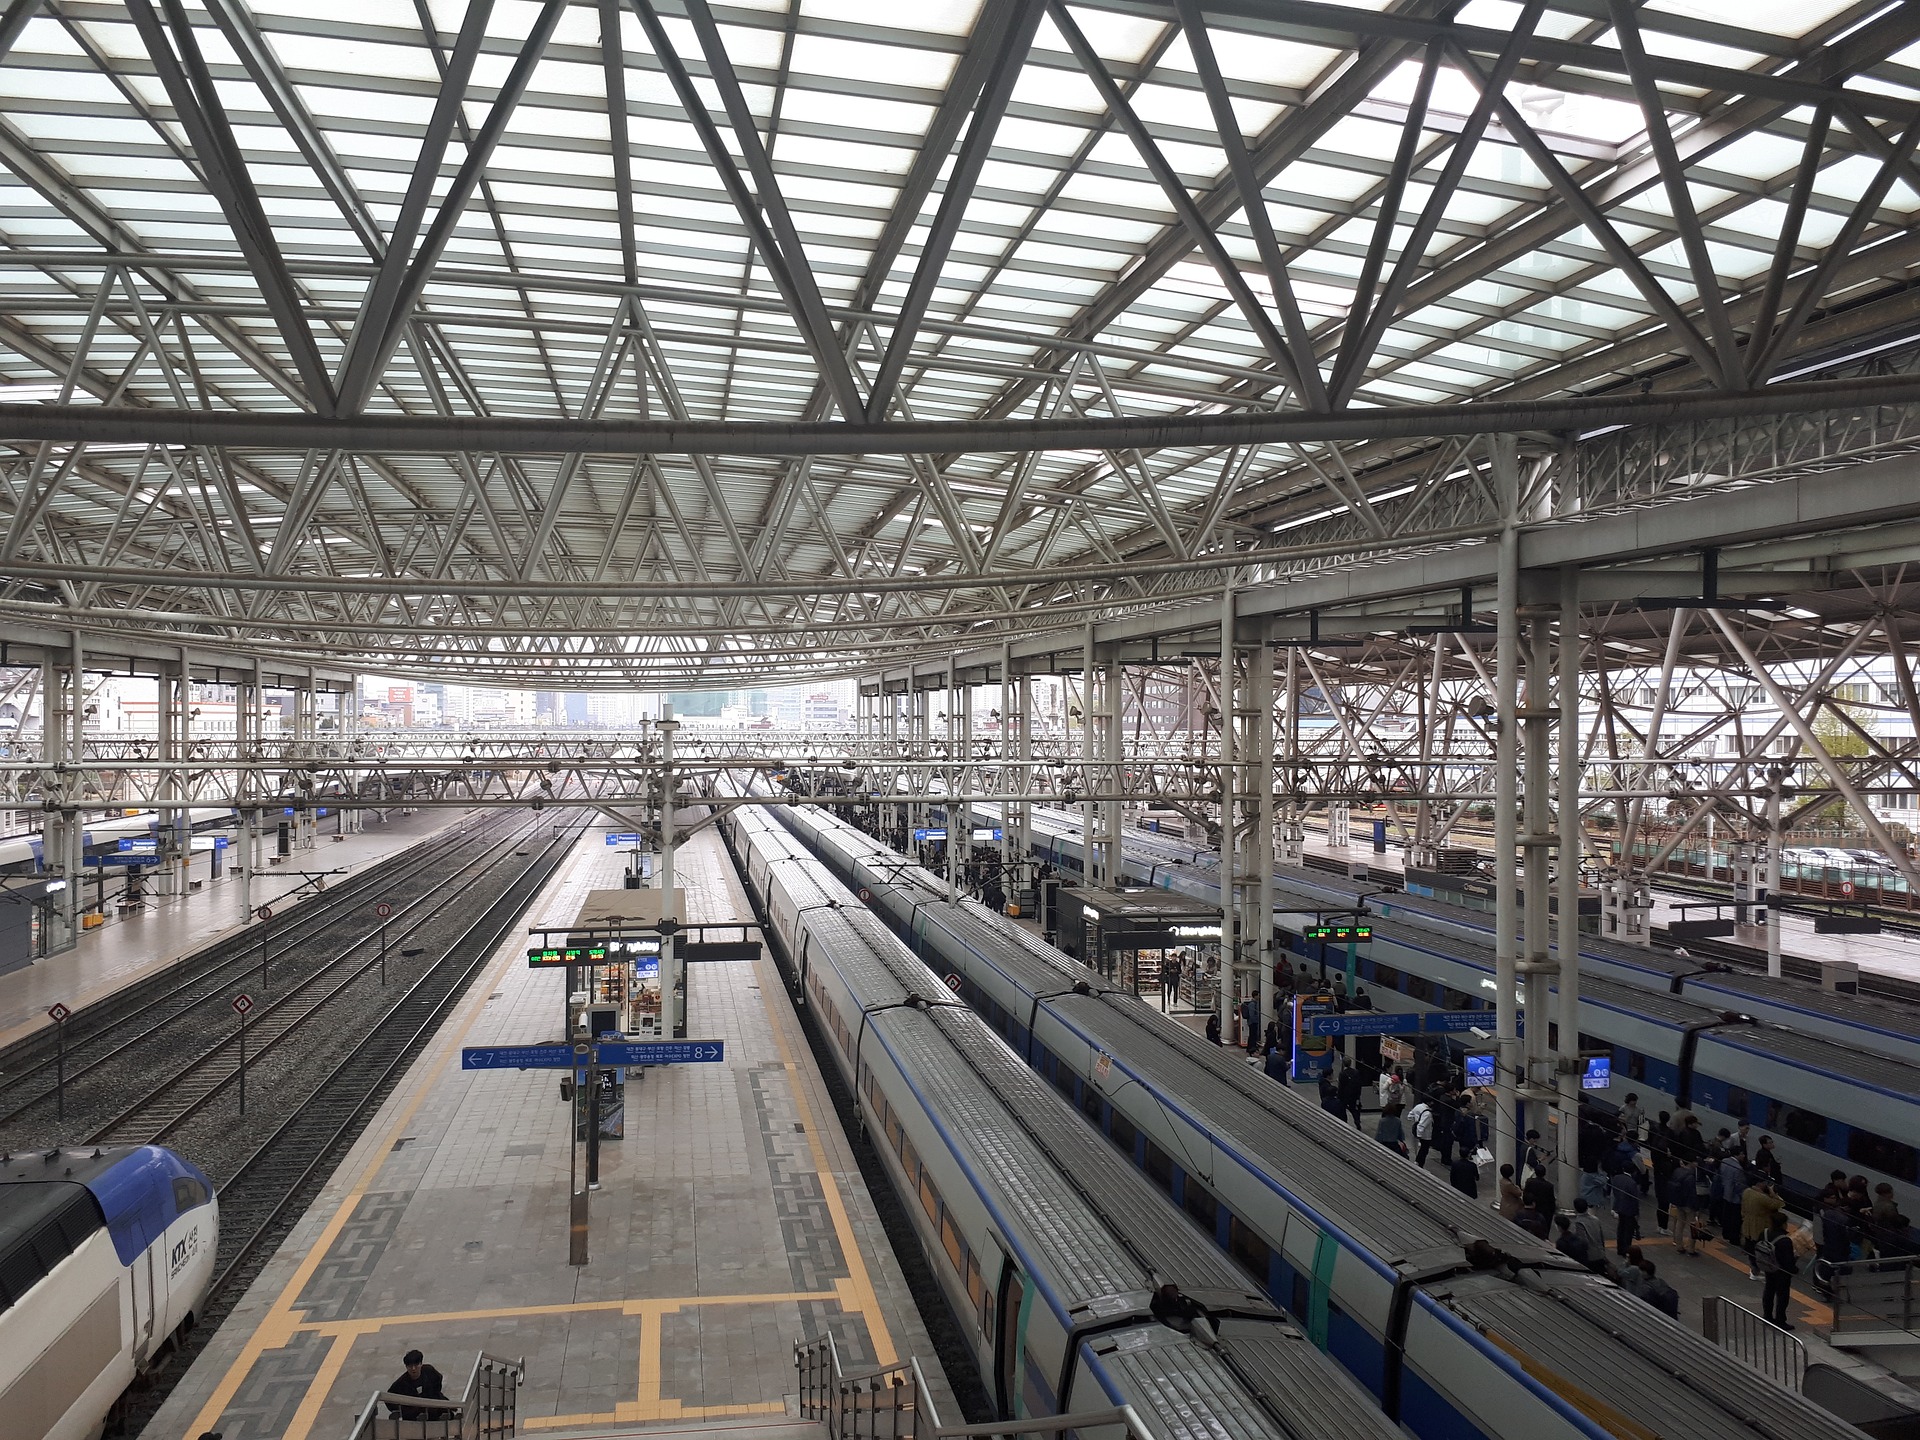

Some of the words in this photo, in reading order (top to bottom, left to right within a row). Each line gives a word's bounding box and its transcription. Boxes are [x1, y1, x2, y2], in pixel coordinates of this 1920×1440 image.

[1332, 1020, 1341, 1032] 9
[486, 1052, 495, 1065] 7
[694, 1046, 703, 1059] 8
[171, 1230, 189, 1269] KTX
